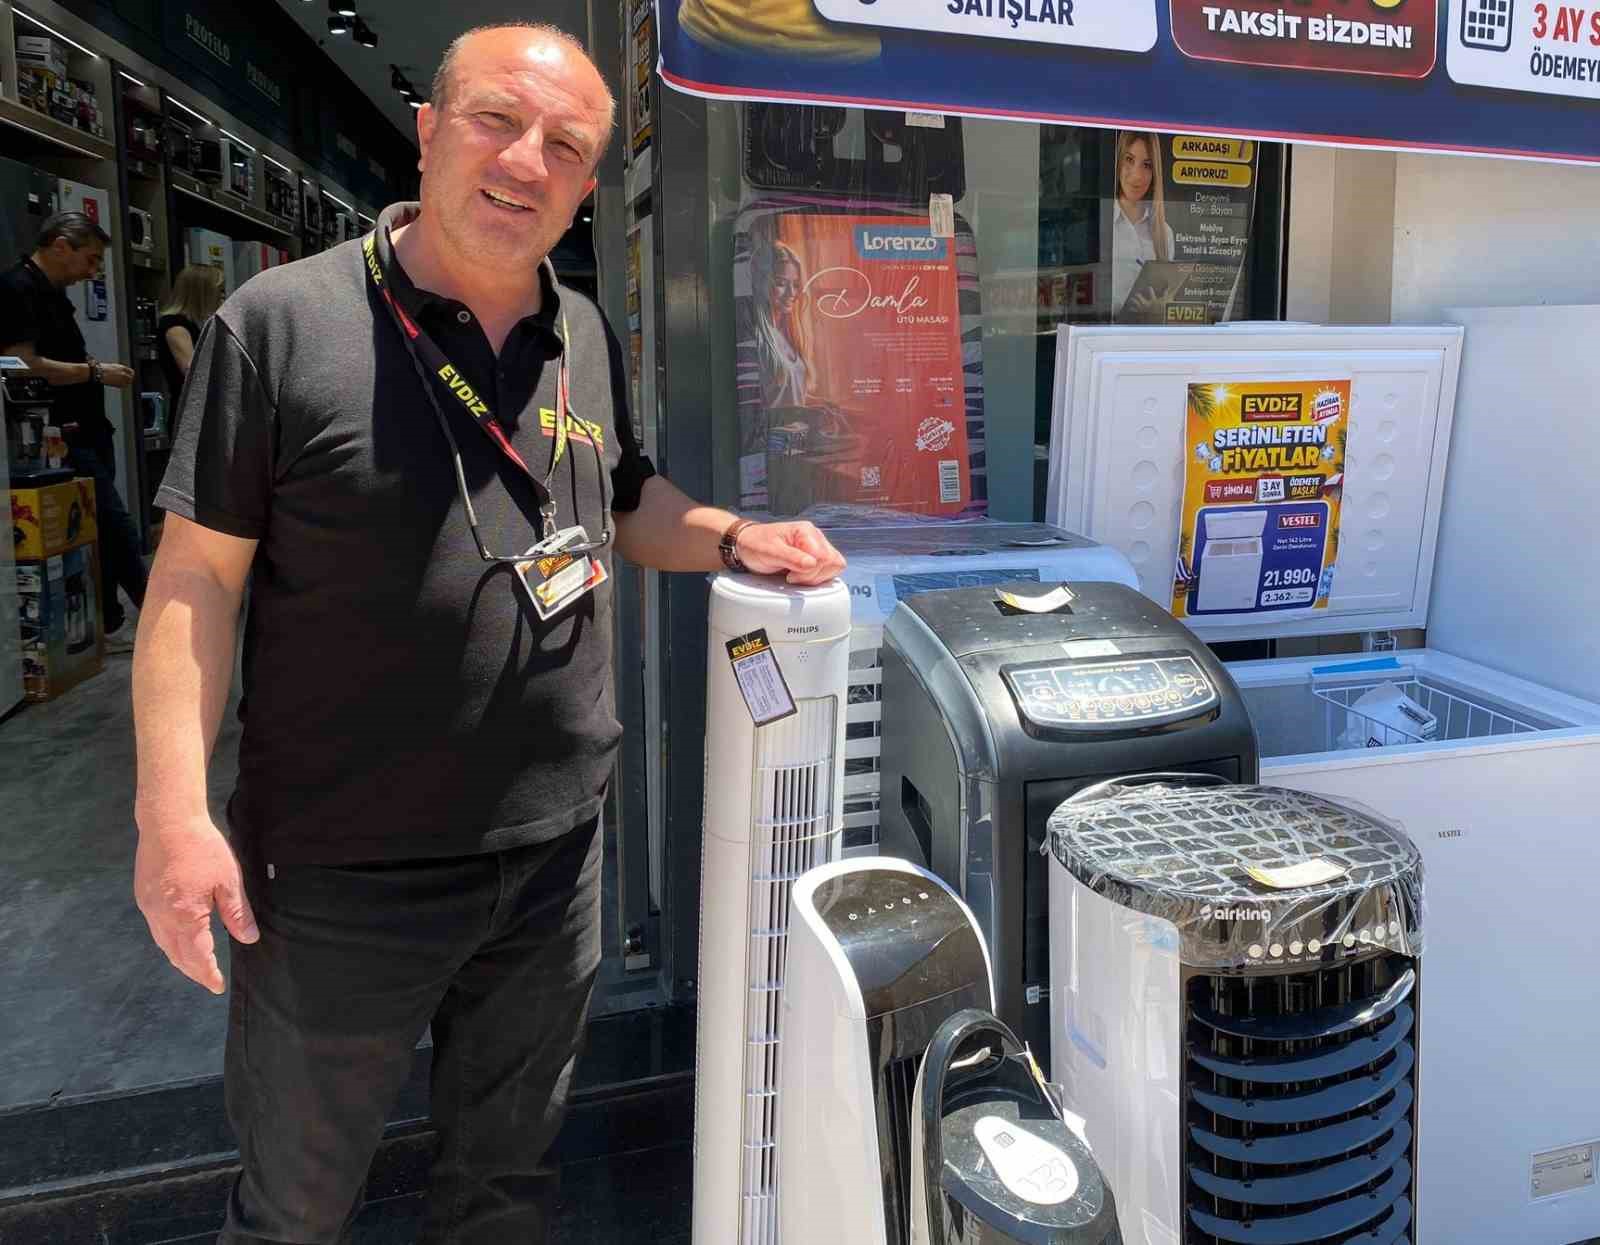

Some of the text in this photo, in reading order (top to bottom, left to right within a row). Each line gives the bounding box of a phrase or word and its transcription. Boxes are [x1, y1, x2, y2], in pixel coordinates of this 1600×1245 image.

[1202, 7, 1413, 49] TAKSİT BİZDEN!
[1532, 3, 1548, 38] 3
[1553, 7, 1585, 43] AY
[1530, 45, 1600, 82] ÖDEMEY
[863, 231, 937, 251] Lorenzo
[802, 267, 929, 319] Damla
[1263, 481, 1281, 491] 3 AY
[1281, 515, 1317, 528] VESTEL
[787, 625, 819, 634] PHILIPS
[1214, 906, 1272, 922] airking
